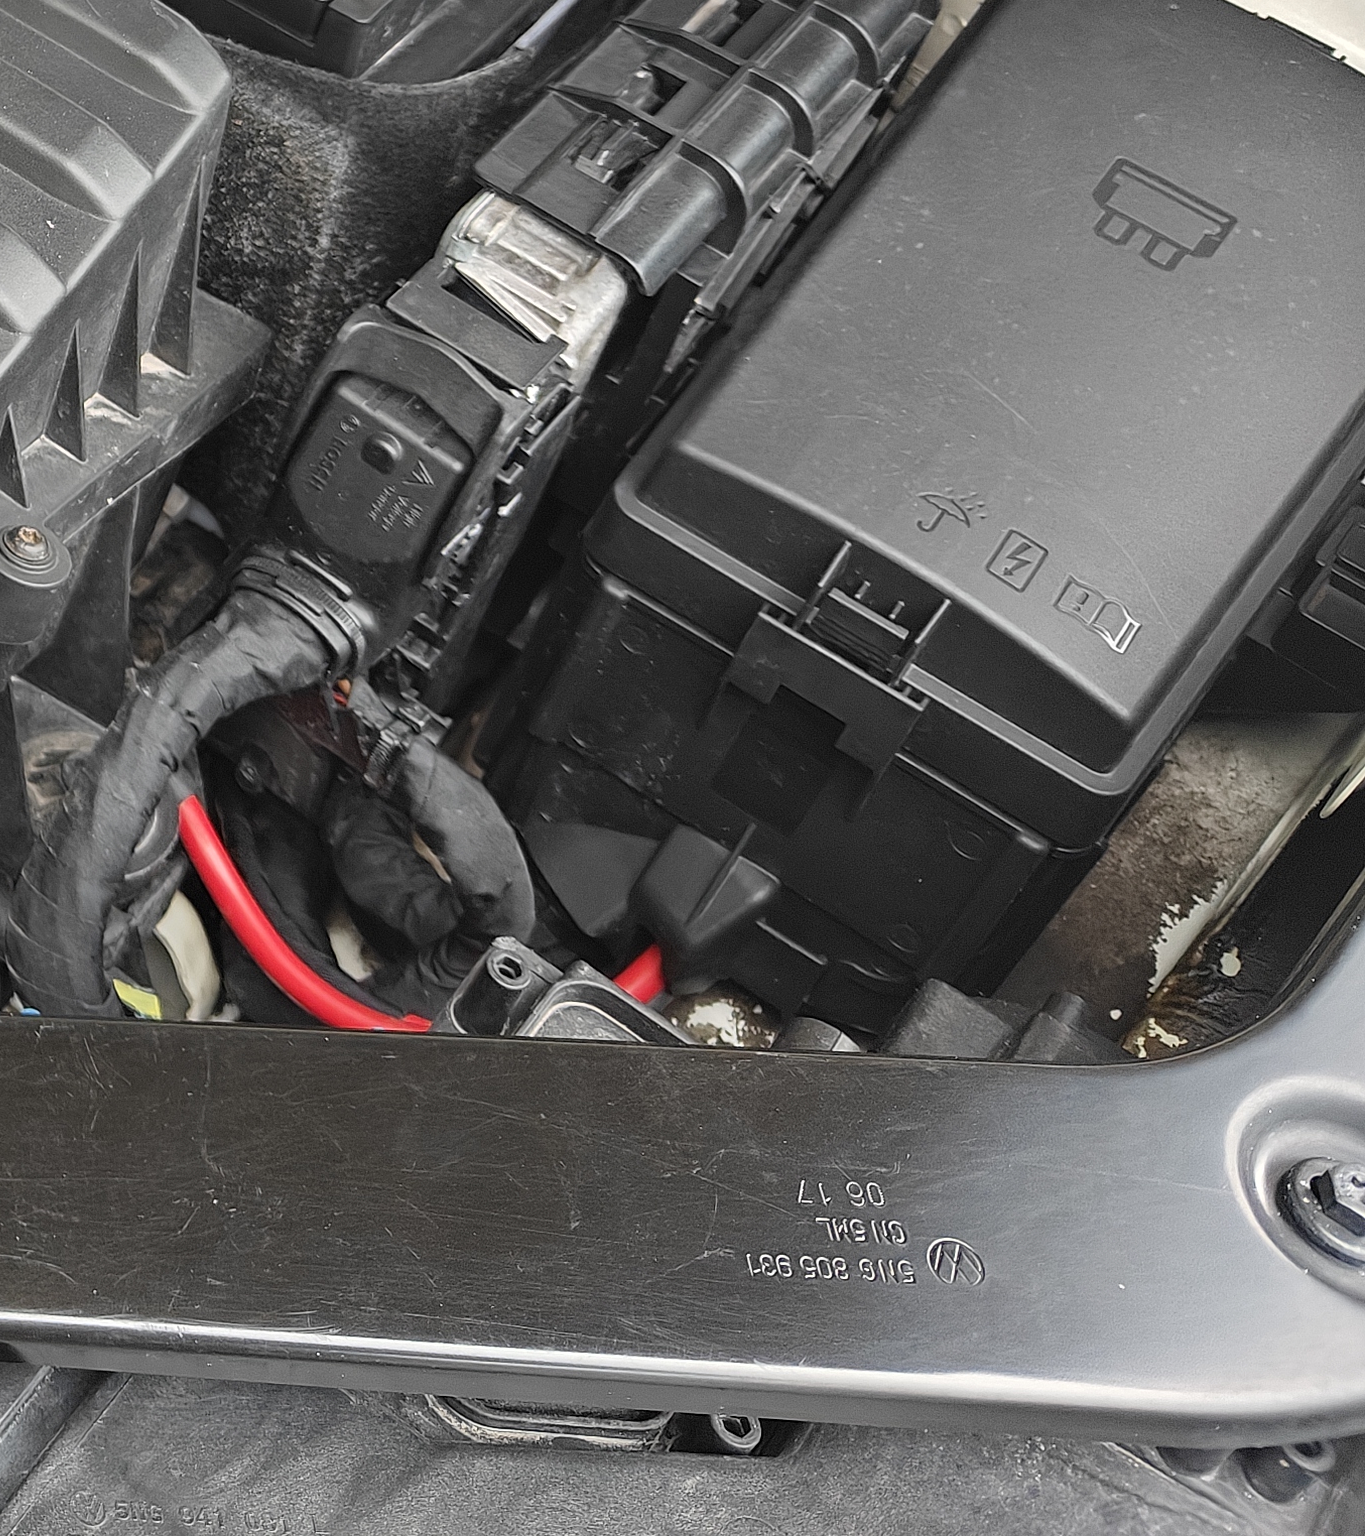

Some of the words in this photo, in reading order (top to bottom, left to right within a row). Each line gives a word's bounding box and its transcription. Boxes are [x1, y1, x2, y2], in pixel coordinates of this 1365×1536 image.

[797, 1179, 832, 1207] 17
[845, 1180, 886, 1208] 06
[871, 1219, 908, 1245] CN
[745, 1253, 795, 1279] 931
[799, 1254, 851, 1282] 805
